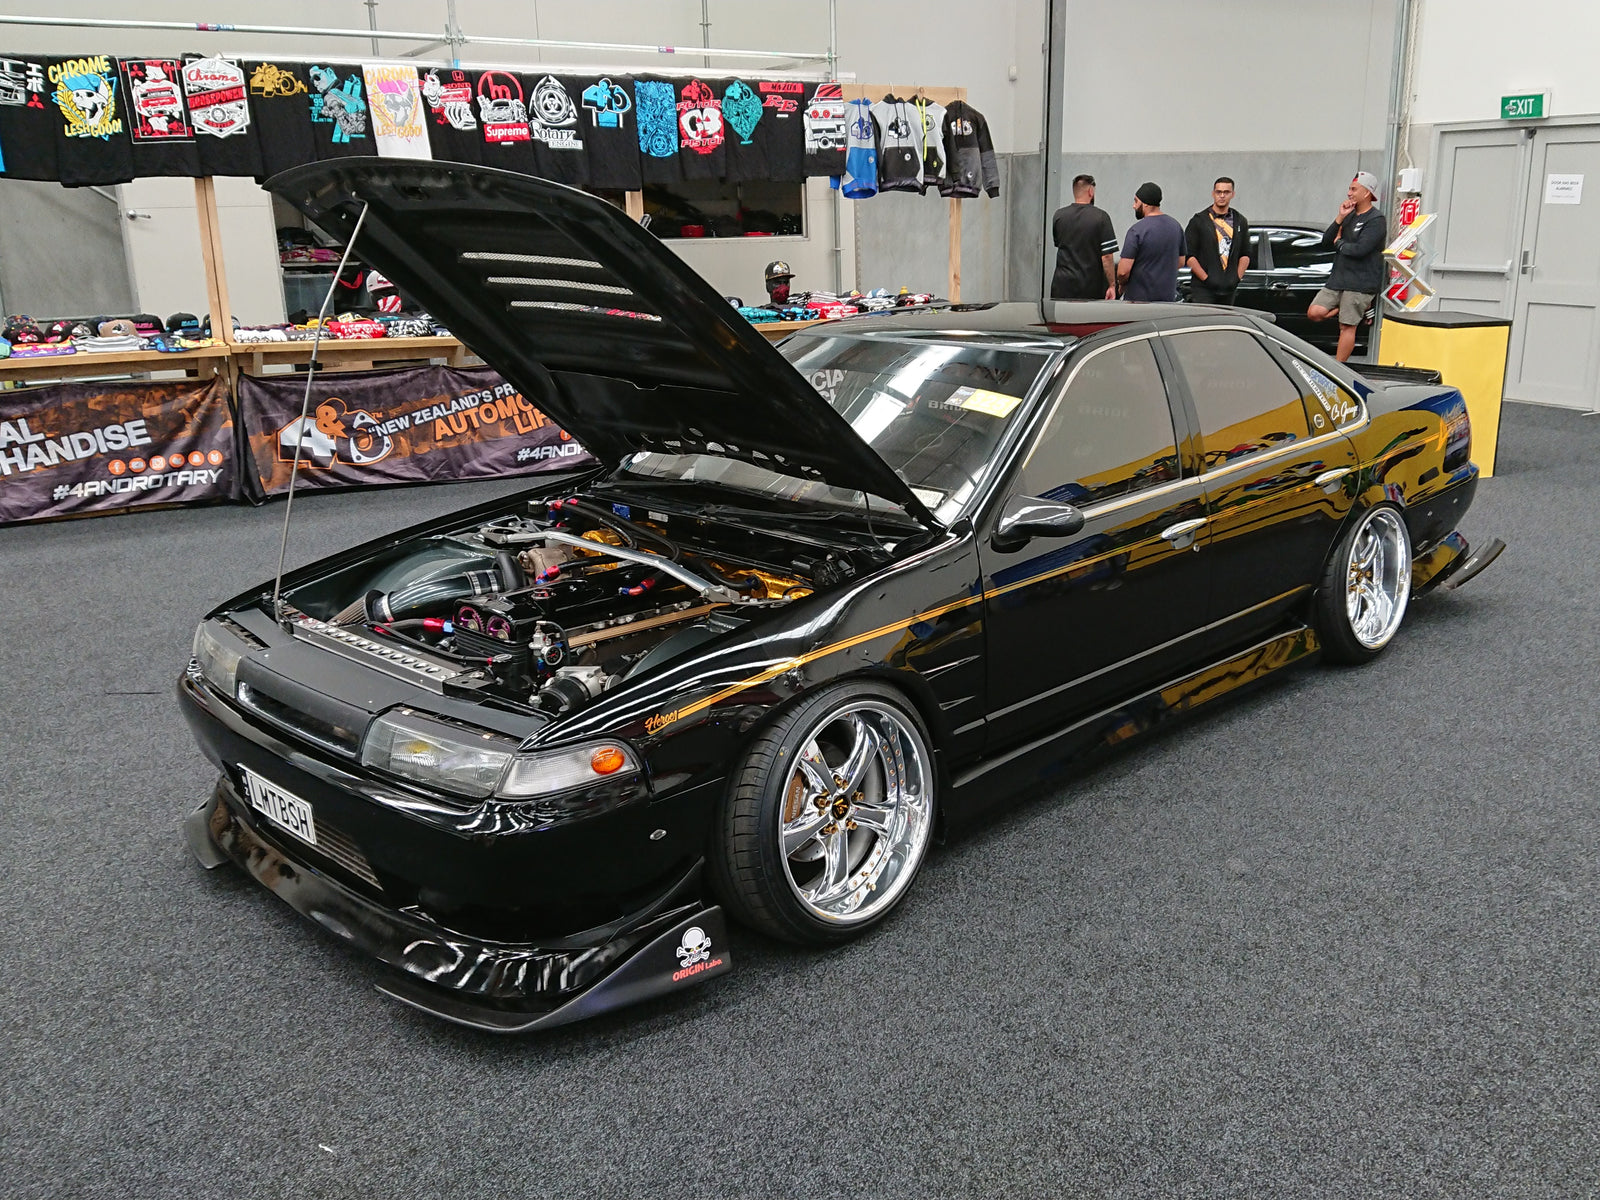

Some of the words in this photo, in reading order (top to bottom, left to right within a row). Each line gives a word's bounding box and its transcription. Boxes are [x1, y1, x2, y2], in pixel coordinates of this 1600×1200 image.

[48, 55, 111, 84] CHROME
[187, 69, 239, 82] Chrome
[365, 67, 417, 86] CHROME
[676, 100, 722, 110] ROTOR
[1509, 98, 1535, 115] EXIT
[64, 122, 90, 137] LESH
[486, 126, 529, 139] Supreme
[529, 120, 577, 142] Rotary
[494, 382, 519, 398] PR
[0, 419, 152, 476] HANDISE
[53, 468, 223, 500] #4ANDROTARY
[250, 776, 311, 839] LMTBSH
[672, 962, 705, 982] ORIGIN
